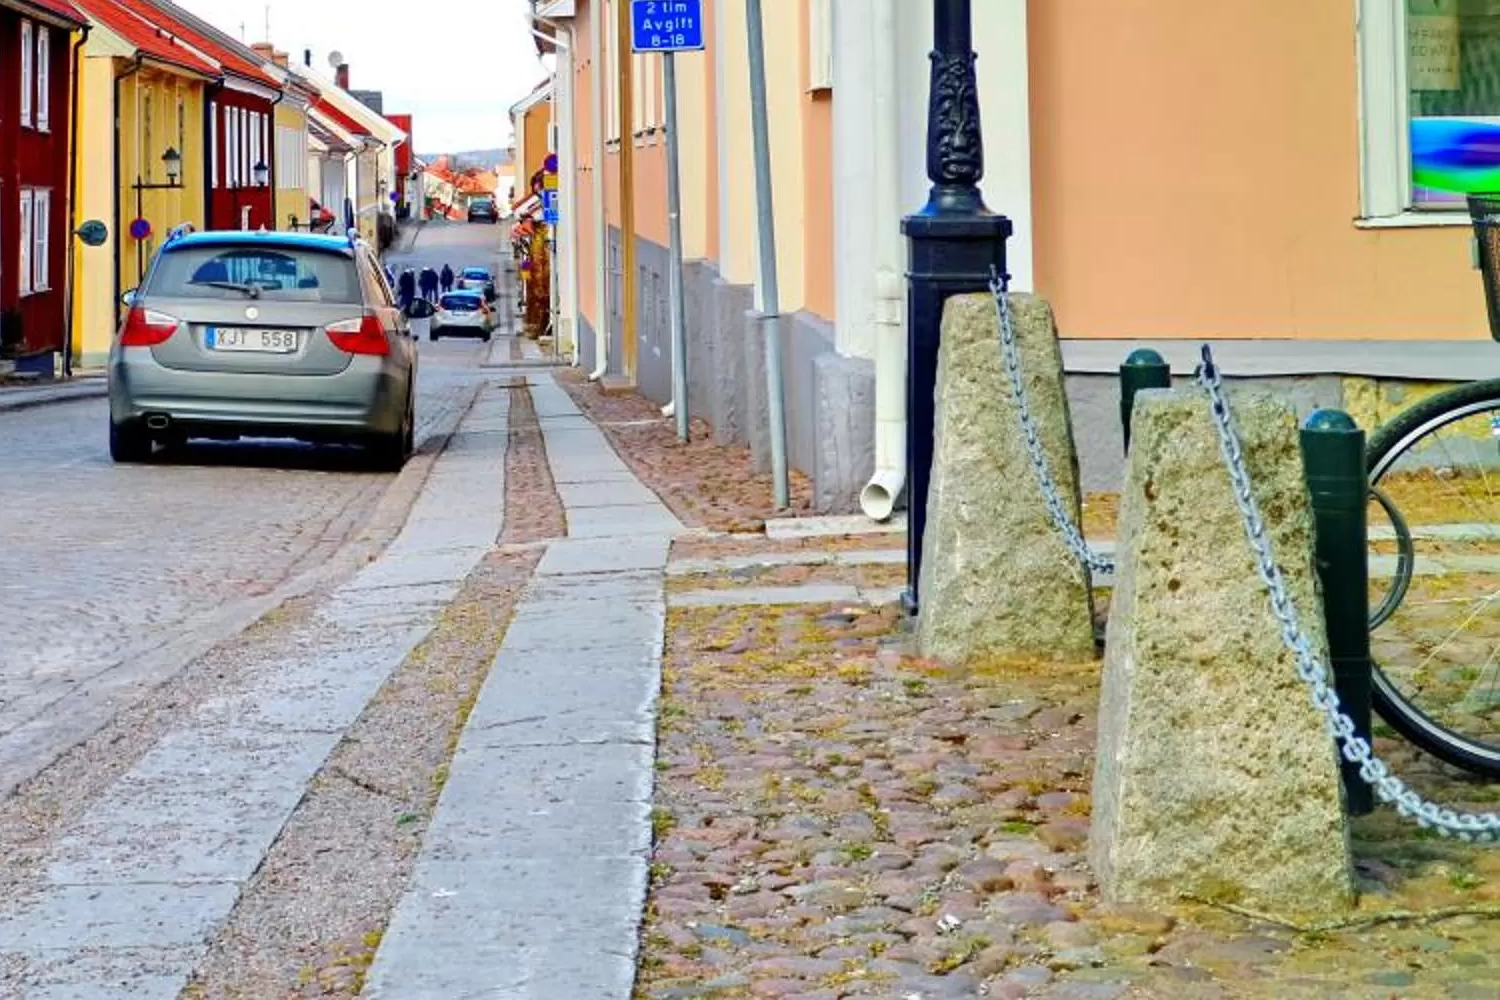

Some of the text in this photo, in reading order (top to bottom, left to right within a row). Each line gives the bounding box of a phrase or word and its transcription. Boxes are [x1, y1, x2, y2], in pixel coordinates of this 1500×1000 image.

[646, 0, 687, 15] 2 tim
[642, 16, 693, 33] Avgift
[651, 33, 686, 47] 8-18
[217, 328, 294, 347] XJT 558
